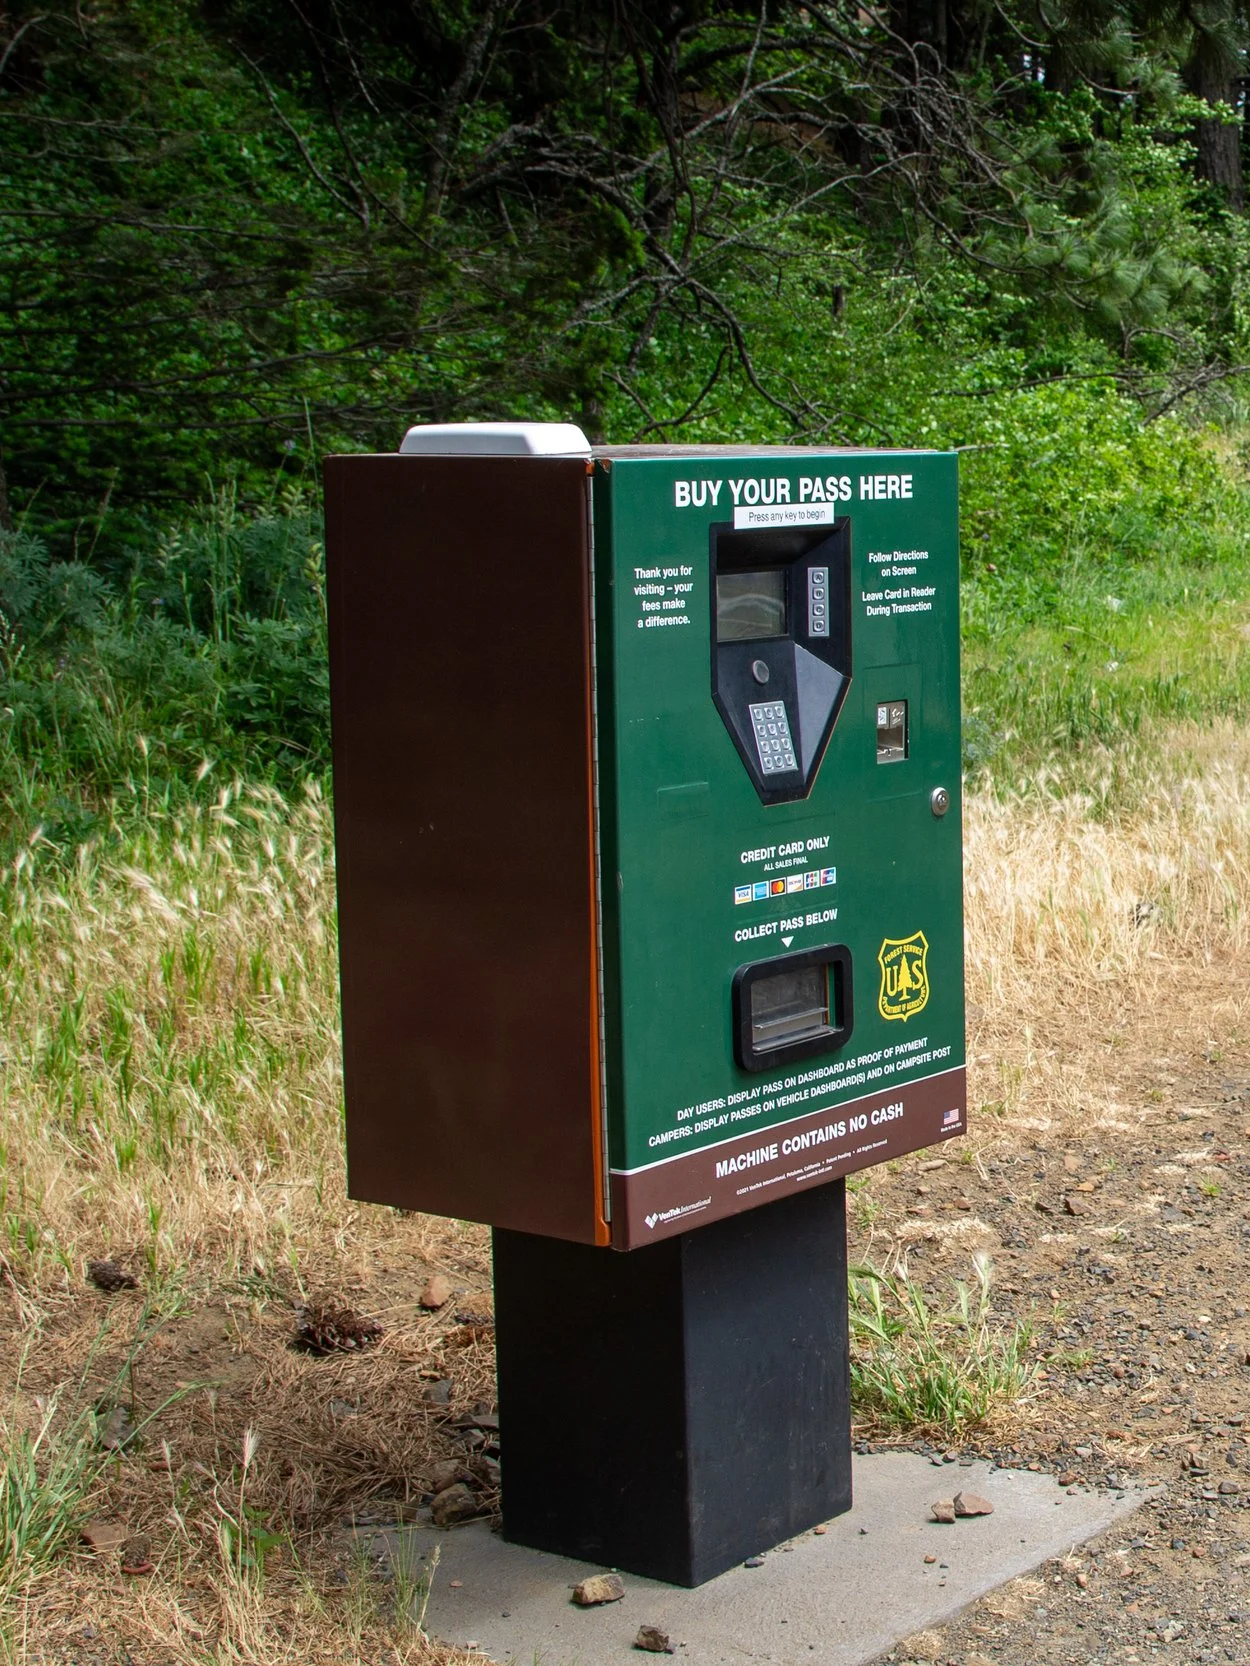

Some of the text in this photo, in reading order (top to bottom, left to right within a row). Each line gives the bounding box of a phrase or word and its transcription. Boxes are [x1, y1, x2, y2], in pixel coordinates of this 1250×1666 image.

[675, 475, 913, 507] BUY YOUR PASS HERE
[749, 509, 826, 523] Press any key to begin
[868, 549, 929, 563] Follow Directions
[634, 565, 693, 580] Thank you for
[881, 565, 917, 577] on Screen
[634, 584, 665, 596] visiting
[673, 582, 694, 594] your
[862, 586, 936, 602] Leave Card in Reader
[642, 598, 686, 612] fees make
[866, 601, 932, 617] During Transaction
[637, 615, 691, 628] a difference.
[740, 836, 830, 864] CREDIT CARD ONLY
[763, 856, 808, 872] ALL SALES FINAL
[737, 890, 749, 898] VISA
[735, 908, 838, 942] COLLECT PASS BELOW
[884, 944, 923, 964] FOREST SERVICE
[677, 1036, 928, 1121] DAY USERS: DISPLAY PASS ON DASHBOARD AS PROOF OF PAYMENT
[648, 1045, 951, 1148] CAMPERS: DISPLAY PASSES ON VEHICLE DASHBOARD(S) AND ON CAMPSITE POST
[715, 1102, 904, 1178] MACHINE CONTAINS NO CASH
